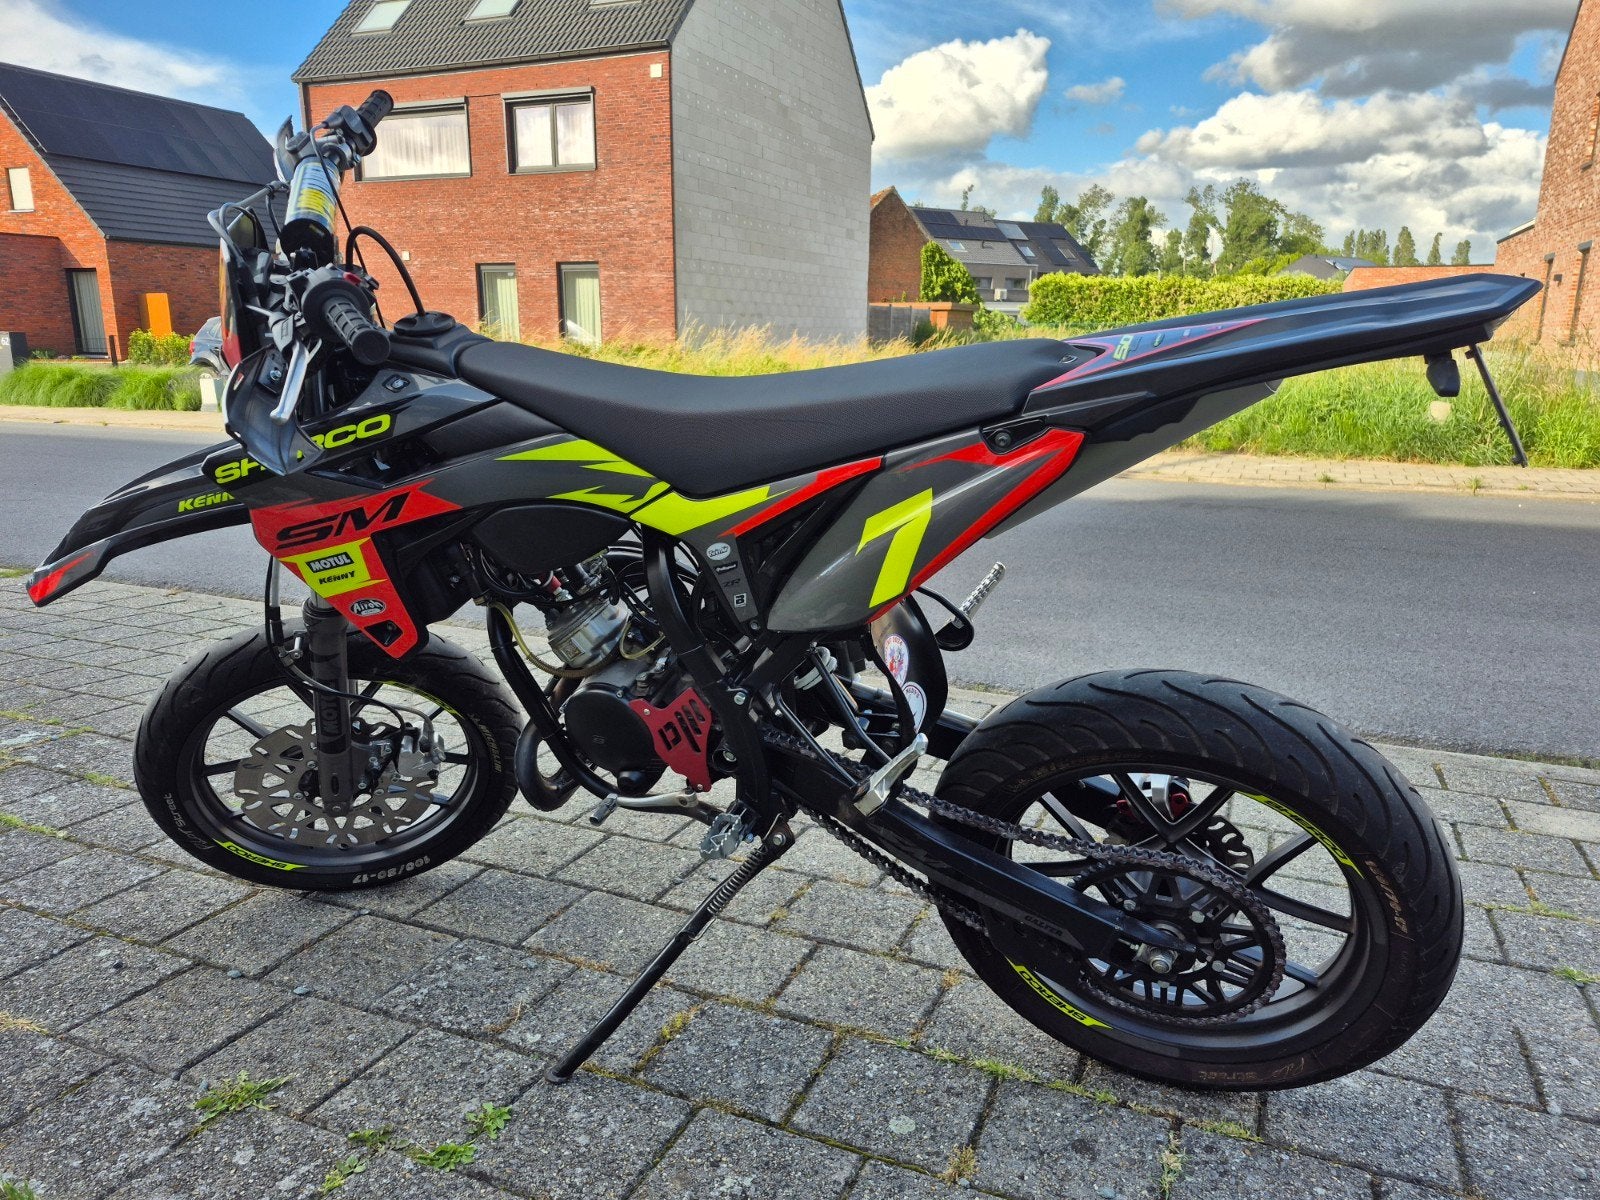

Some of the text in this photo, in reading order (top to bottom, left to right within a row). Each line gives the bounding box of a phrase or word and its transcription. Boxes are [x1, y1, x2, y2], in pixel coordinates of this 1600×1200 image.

[178, 490, 236, 513] KENN
[275, 491, 411, 550] SM
[309, 554, 351, 572] MOTUL
[318, 571, 356, 585] KENNY
[1019, 970, 1087, 1021] SHERCO
